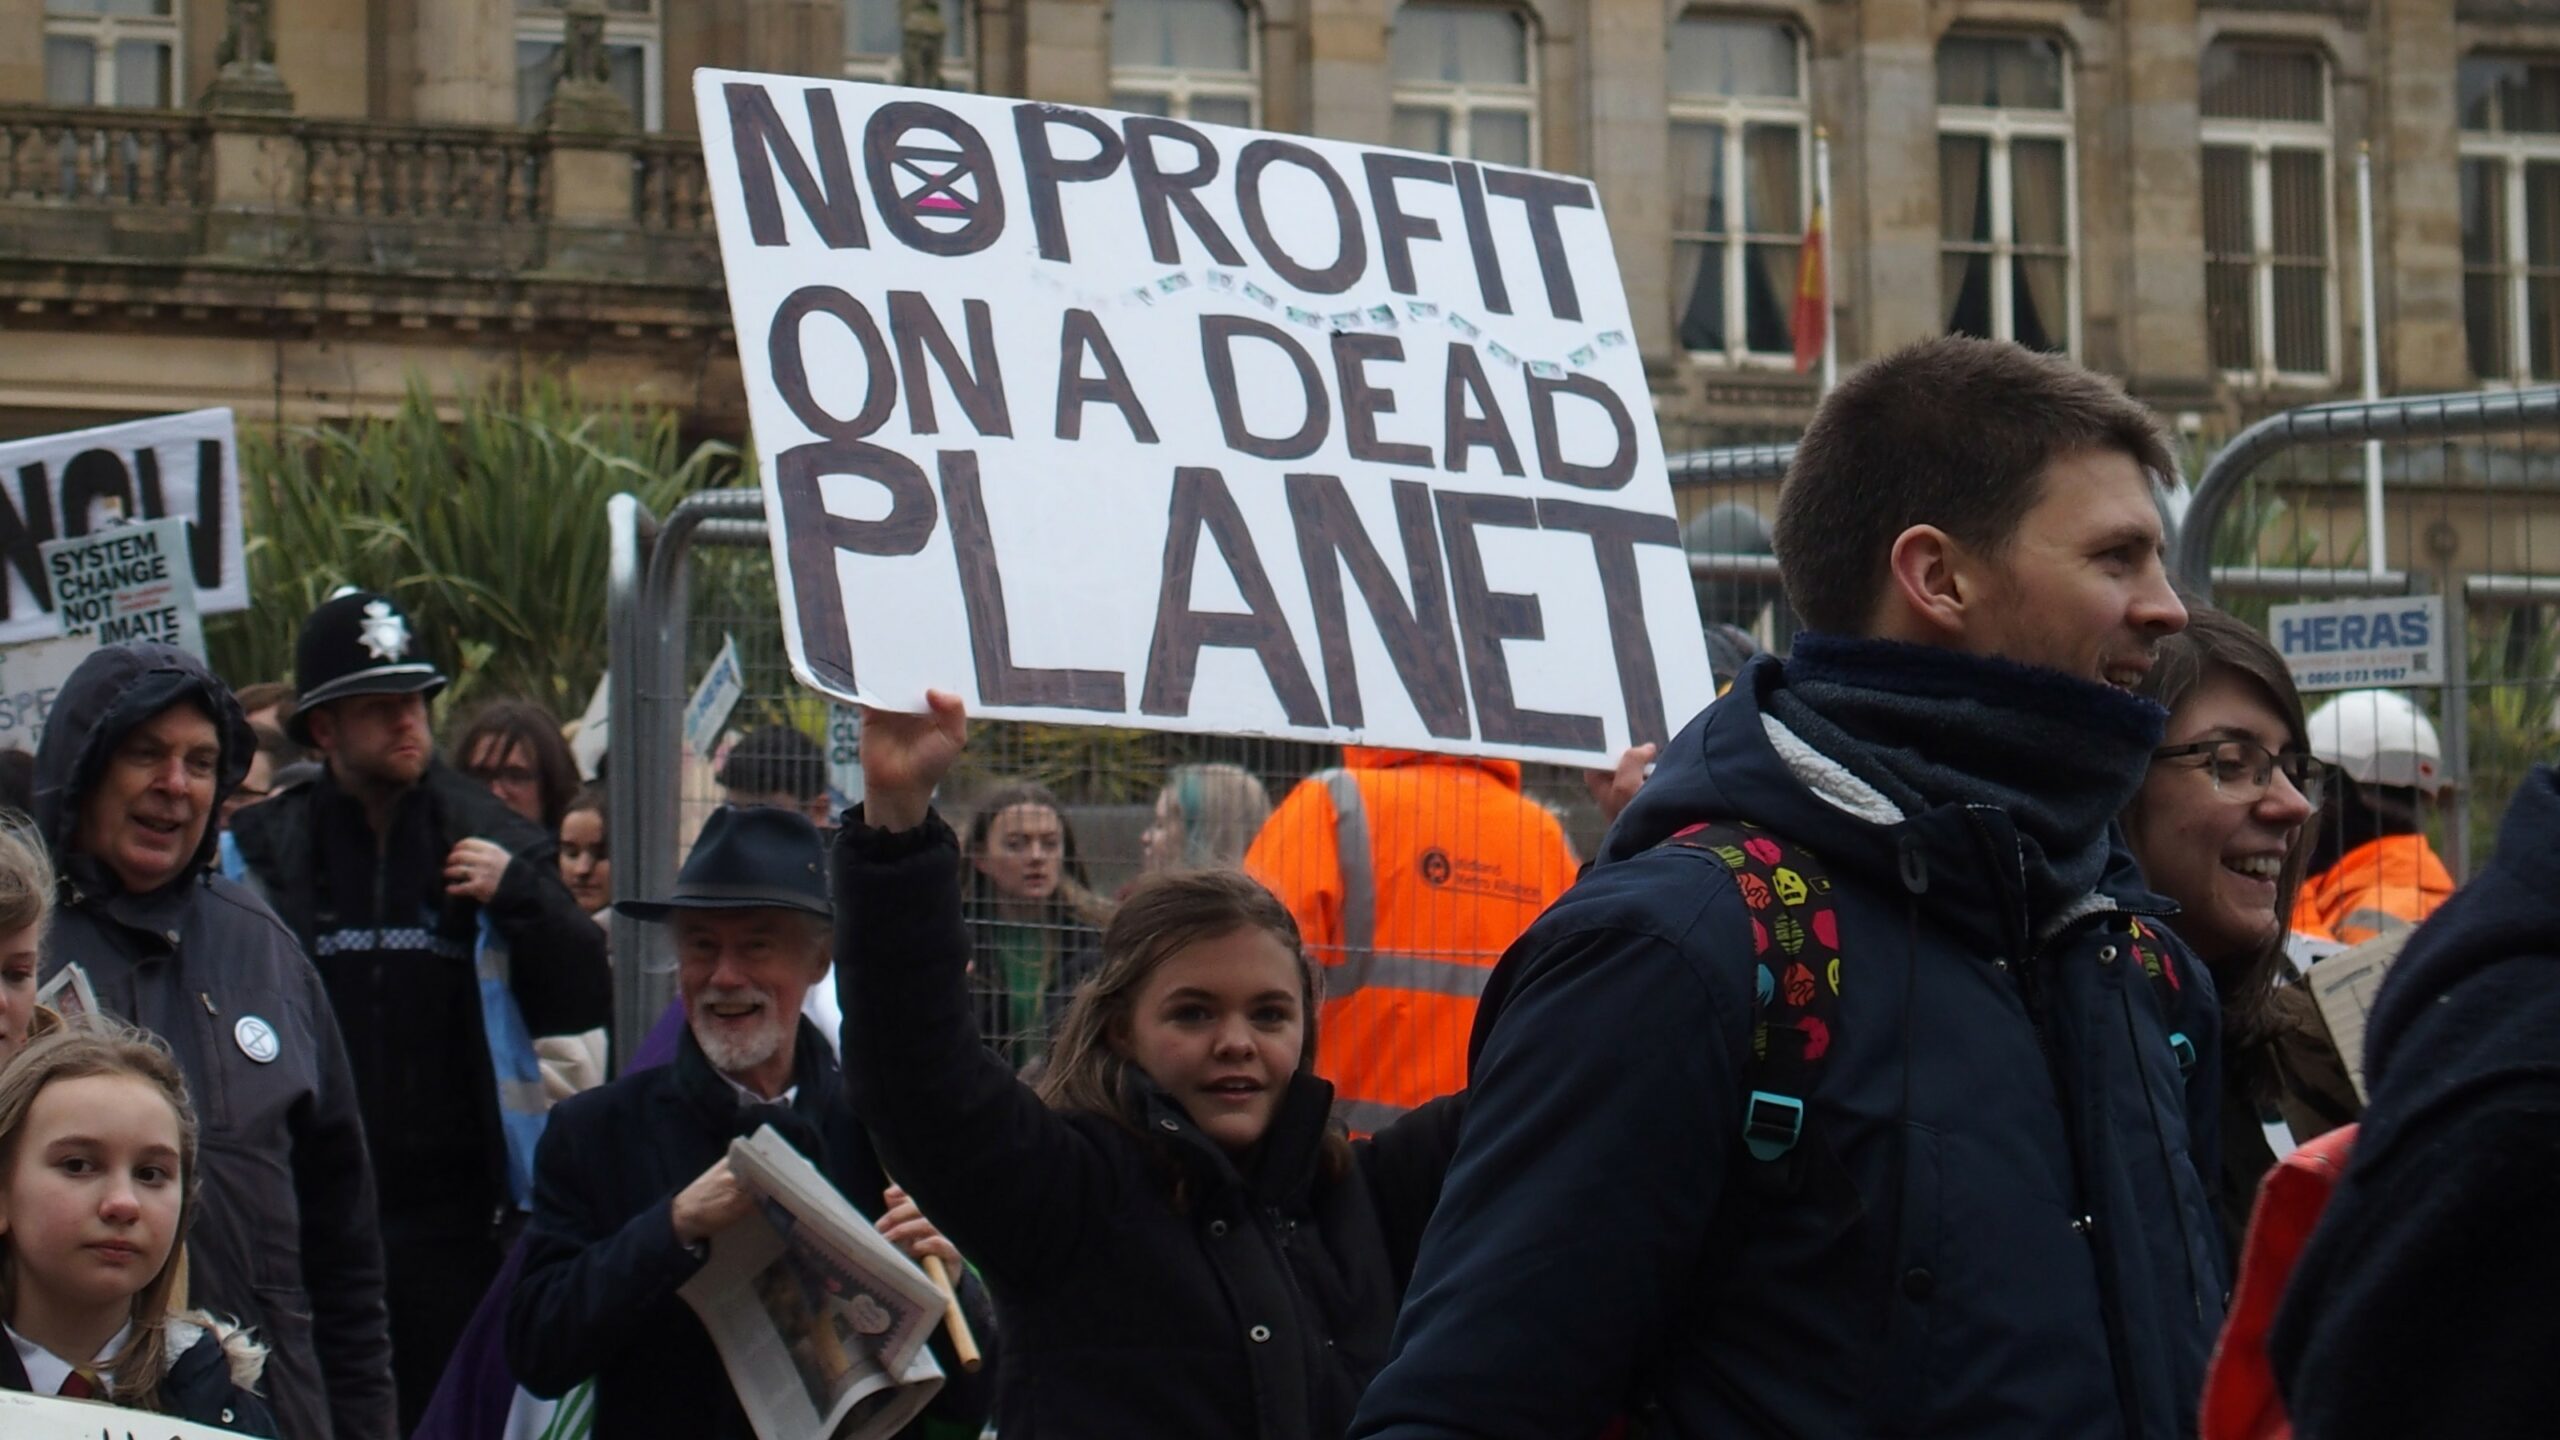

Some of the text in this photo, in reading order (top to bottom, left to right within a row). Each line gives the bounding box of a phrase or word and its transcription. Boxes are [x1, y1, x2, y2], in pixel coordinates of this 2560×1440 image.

[723, 83, 1594, 322] NO PROFIT
[769, 285, 1638, 490] ON A DEAD
[52, 532, 158, 576] SYSTEM
[58, 556, 168, 600] CHANGE
[776, 440, 1682, 757] PLANET
[62, 594, 113, 628] NOT
[68, 606, 180, 646] IMATE
[2281, 610, 2429, 654] HERAS
